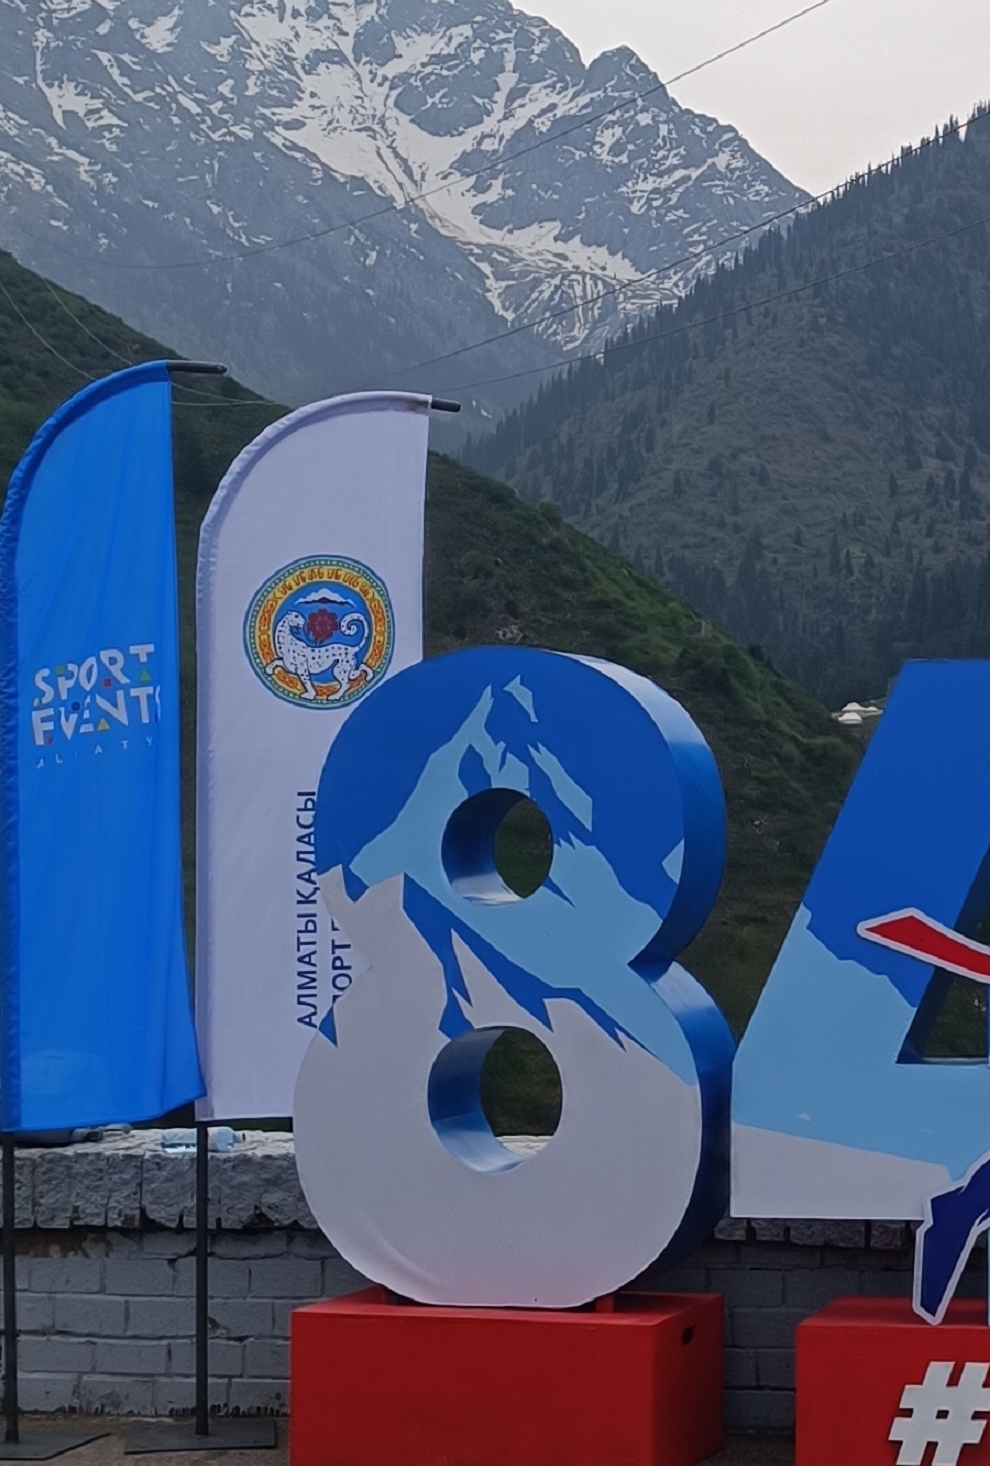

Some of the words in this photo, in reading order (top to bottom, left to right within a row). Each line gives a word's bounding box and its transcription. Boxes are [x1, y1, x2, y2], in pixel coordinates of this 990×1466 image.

[34, 643, 155, 706] SPORT
[37, 735, 153, 769] ALATY
[296, 791, 321, 905] ҚАЛАСЫ
[297, 912, 318, 1030] АЛМАТЫ
[331, 939, 353, 1004] ОРТ
